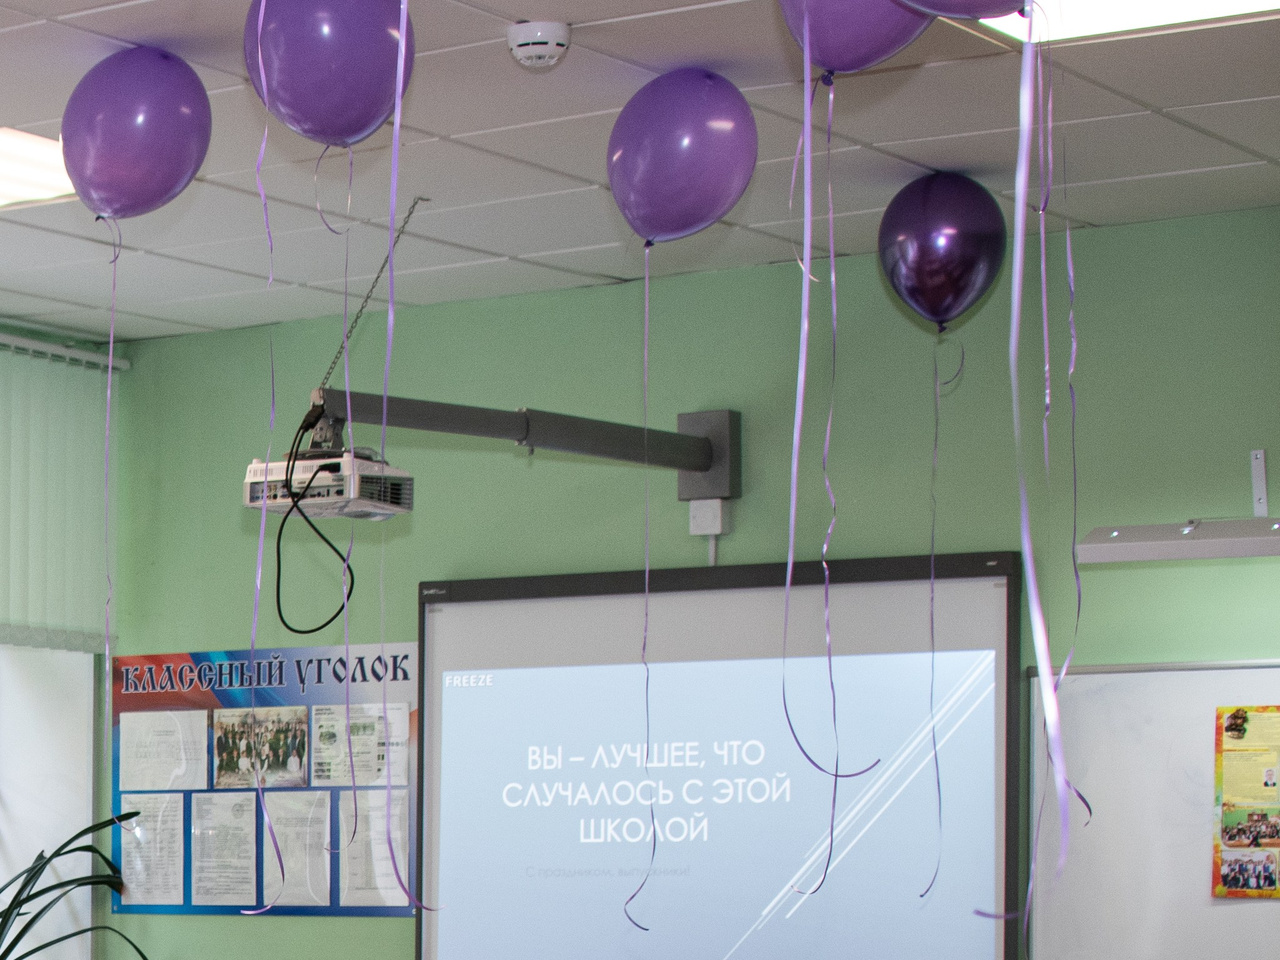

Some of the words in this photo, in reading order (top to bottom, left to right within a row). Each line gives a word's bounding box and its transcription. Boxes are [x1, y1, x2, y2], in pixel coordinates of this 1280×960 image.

[121, 655, 285, 693] КЛАССНЫЙ
[295, 653, 410, 695] УГОЛОК
[445, 674, 494, 688] FREEZE
[527, 746, 563, 770] ВЫ
[591, 743, 706, 769] ЛУЧШЕЕ,
[714, 740, 765, 765] ЧТО
[502, 781, 674, 807] СЛУЧАЛОСЬ
[682, 780, 704, 804] С
[712, 772, 791, 803] ЭТОЙ
[580, 812, 709, 844] ШКОЛОЙ
